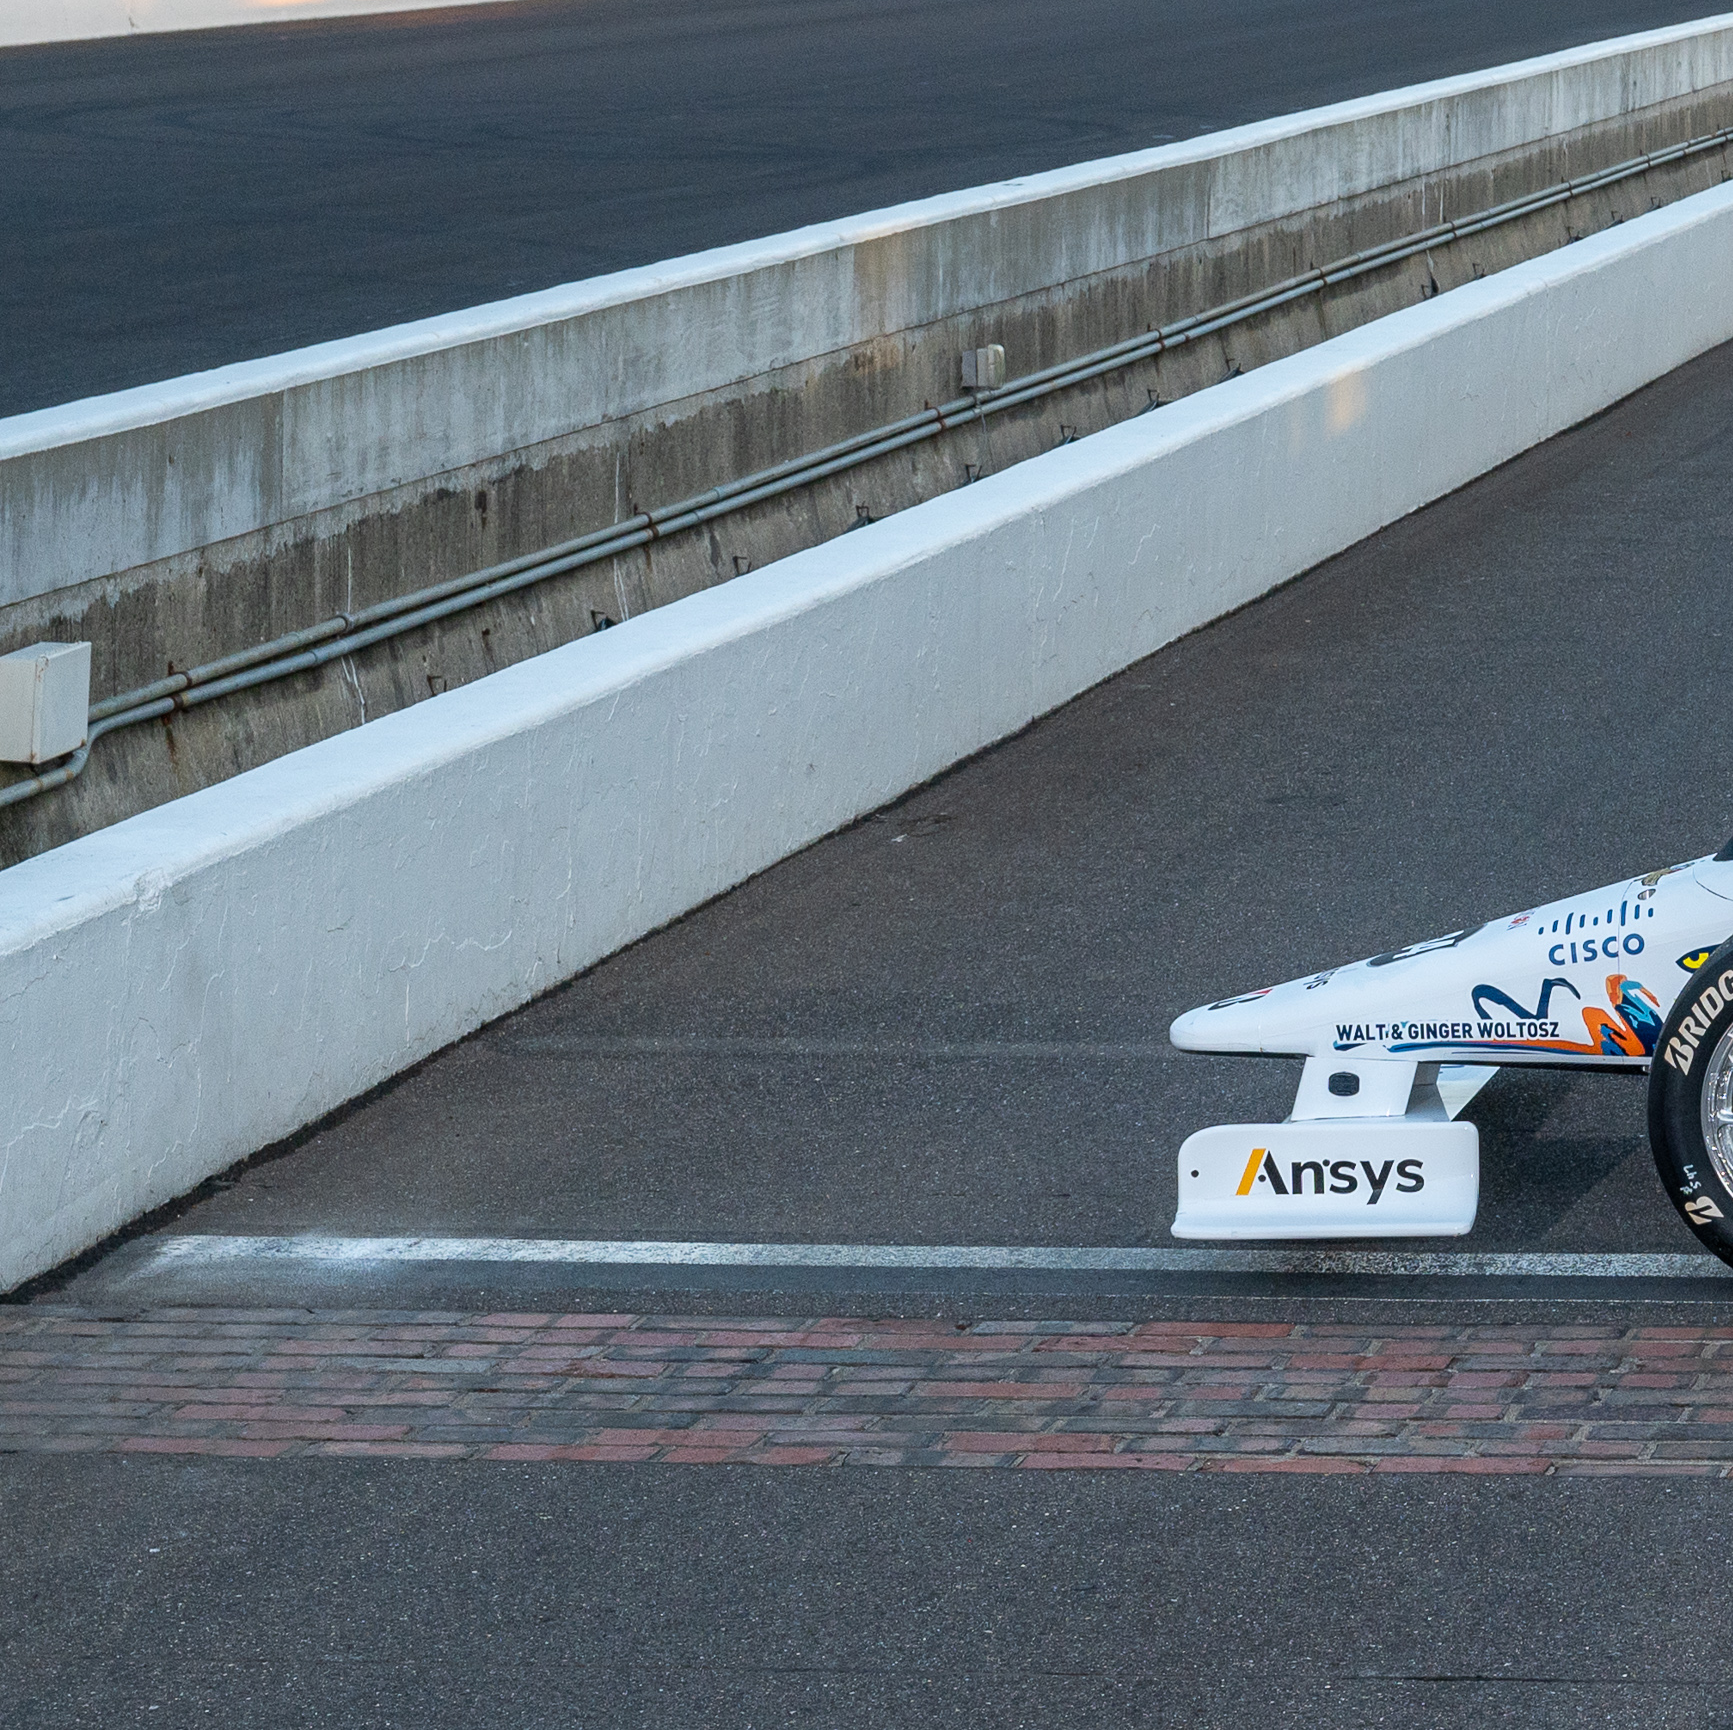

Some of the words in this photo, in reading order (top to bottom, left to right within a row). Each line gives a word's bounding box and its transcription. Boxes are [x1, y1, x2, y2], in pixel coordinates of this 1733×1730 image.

[1549, 933, 1645, 966] CISCO
[1336, 1024, 1387, 1041] WALT
[1391, 1024, 1403, 1040] &
[1408, 1022, 1473, 1039] GINGER
[1477, 1020, 1560, 1039] WOLTOSZ
[1236, 1147, 1425, 1205] Ansys
